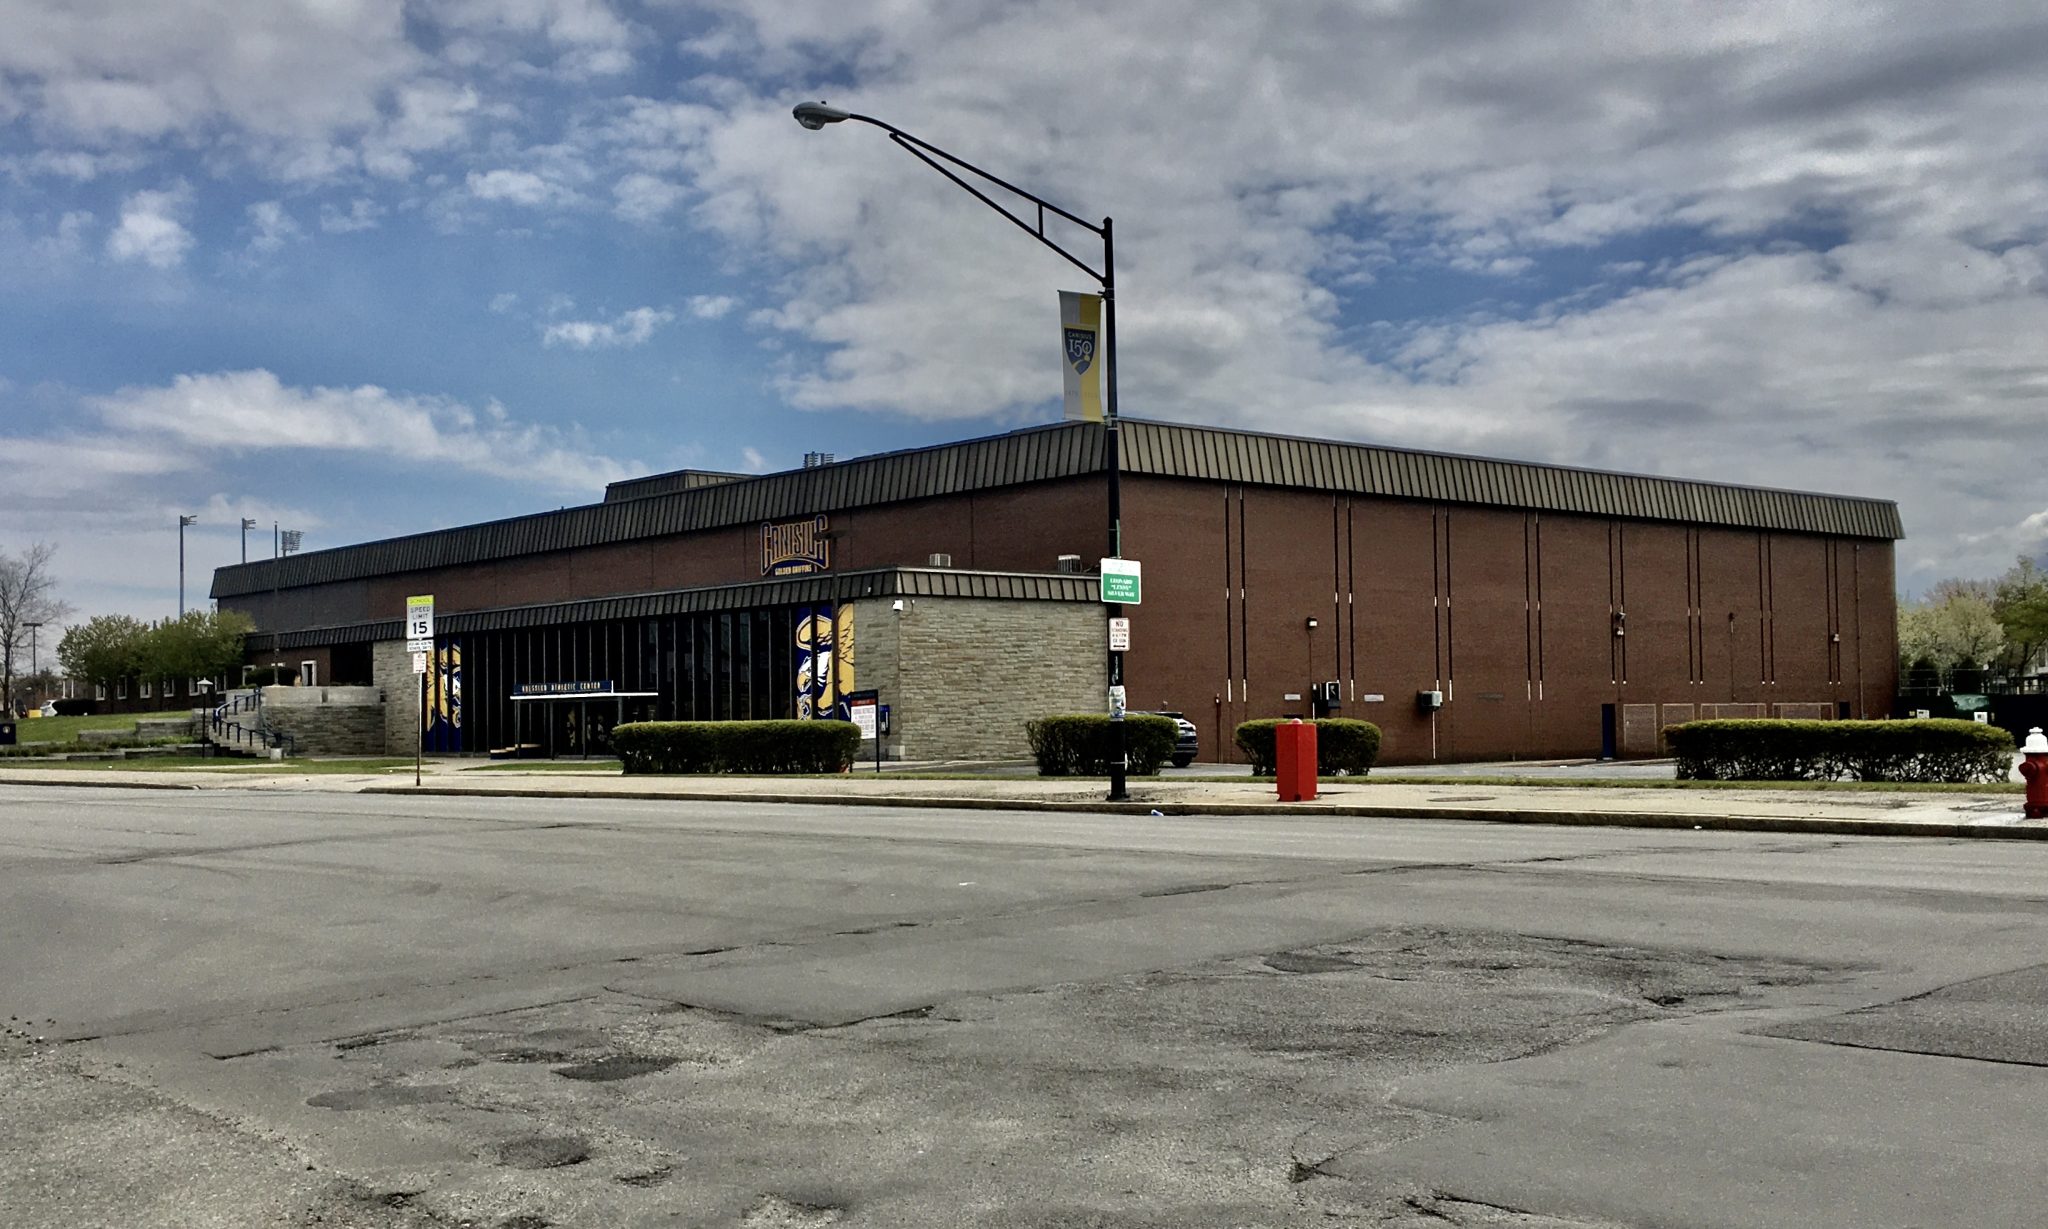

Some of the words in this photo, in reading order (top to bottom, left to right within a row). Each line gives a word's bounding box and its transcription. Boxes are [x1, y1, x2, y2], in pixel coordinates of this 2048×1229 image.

[1069, 339, 1092, 357] 150
[413, 621, 428, 634] 15
[551, 683, 576, 691] ATHLETIC
[580, 681, 600, 690] CENTER
